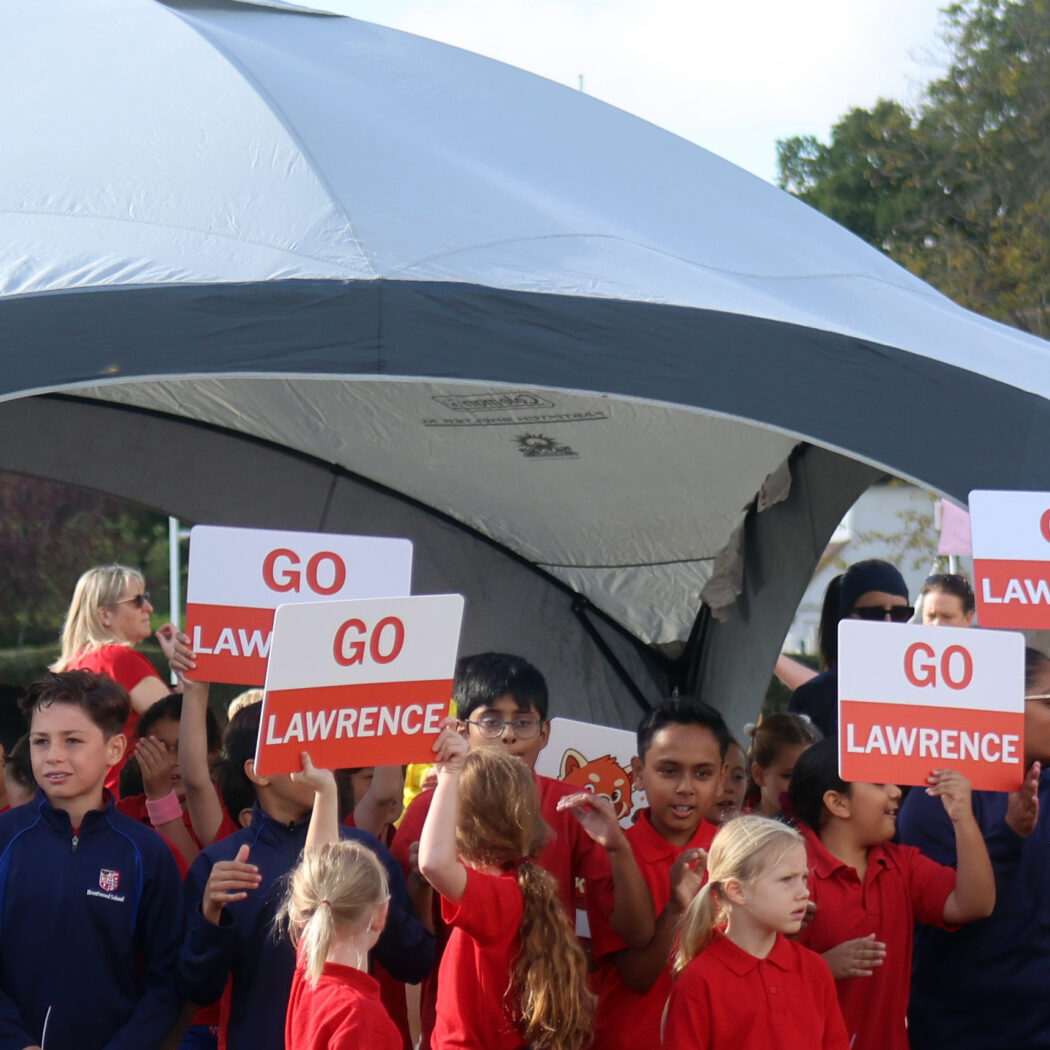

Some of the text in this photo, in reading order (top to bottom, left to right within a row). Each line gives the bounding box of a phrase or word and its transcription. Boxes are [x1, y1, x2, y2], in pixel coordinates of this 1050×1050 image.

[262, 548, 347, 596] GO
[332, 616, 405, 667] GO
[903, 641, 974, 691] GO
[265, 703, 445, 746] LAWRENCE
[846, 723, 1020, 764] LAWRENCE
